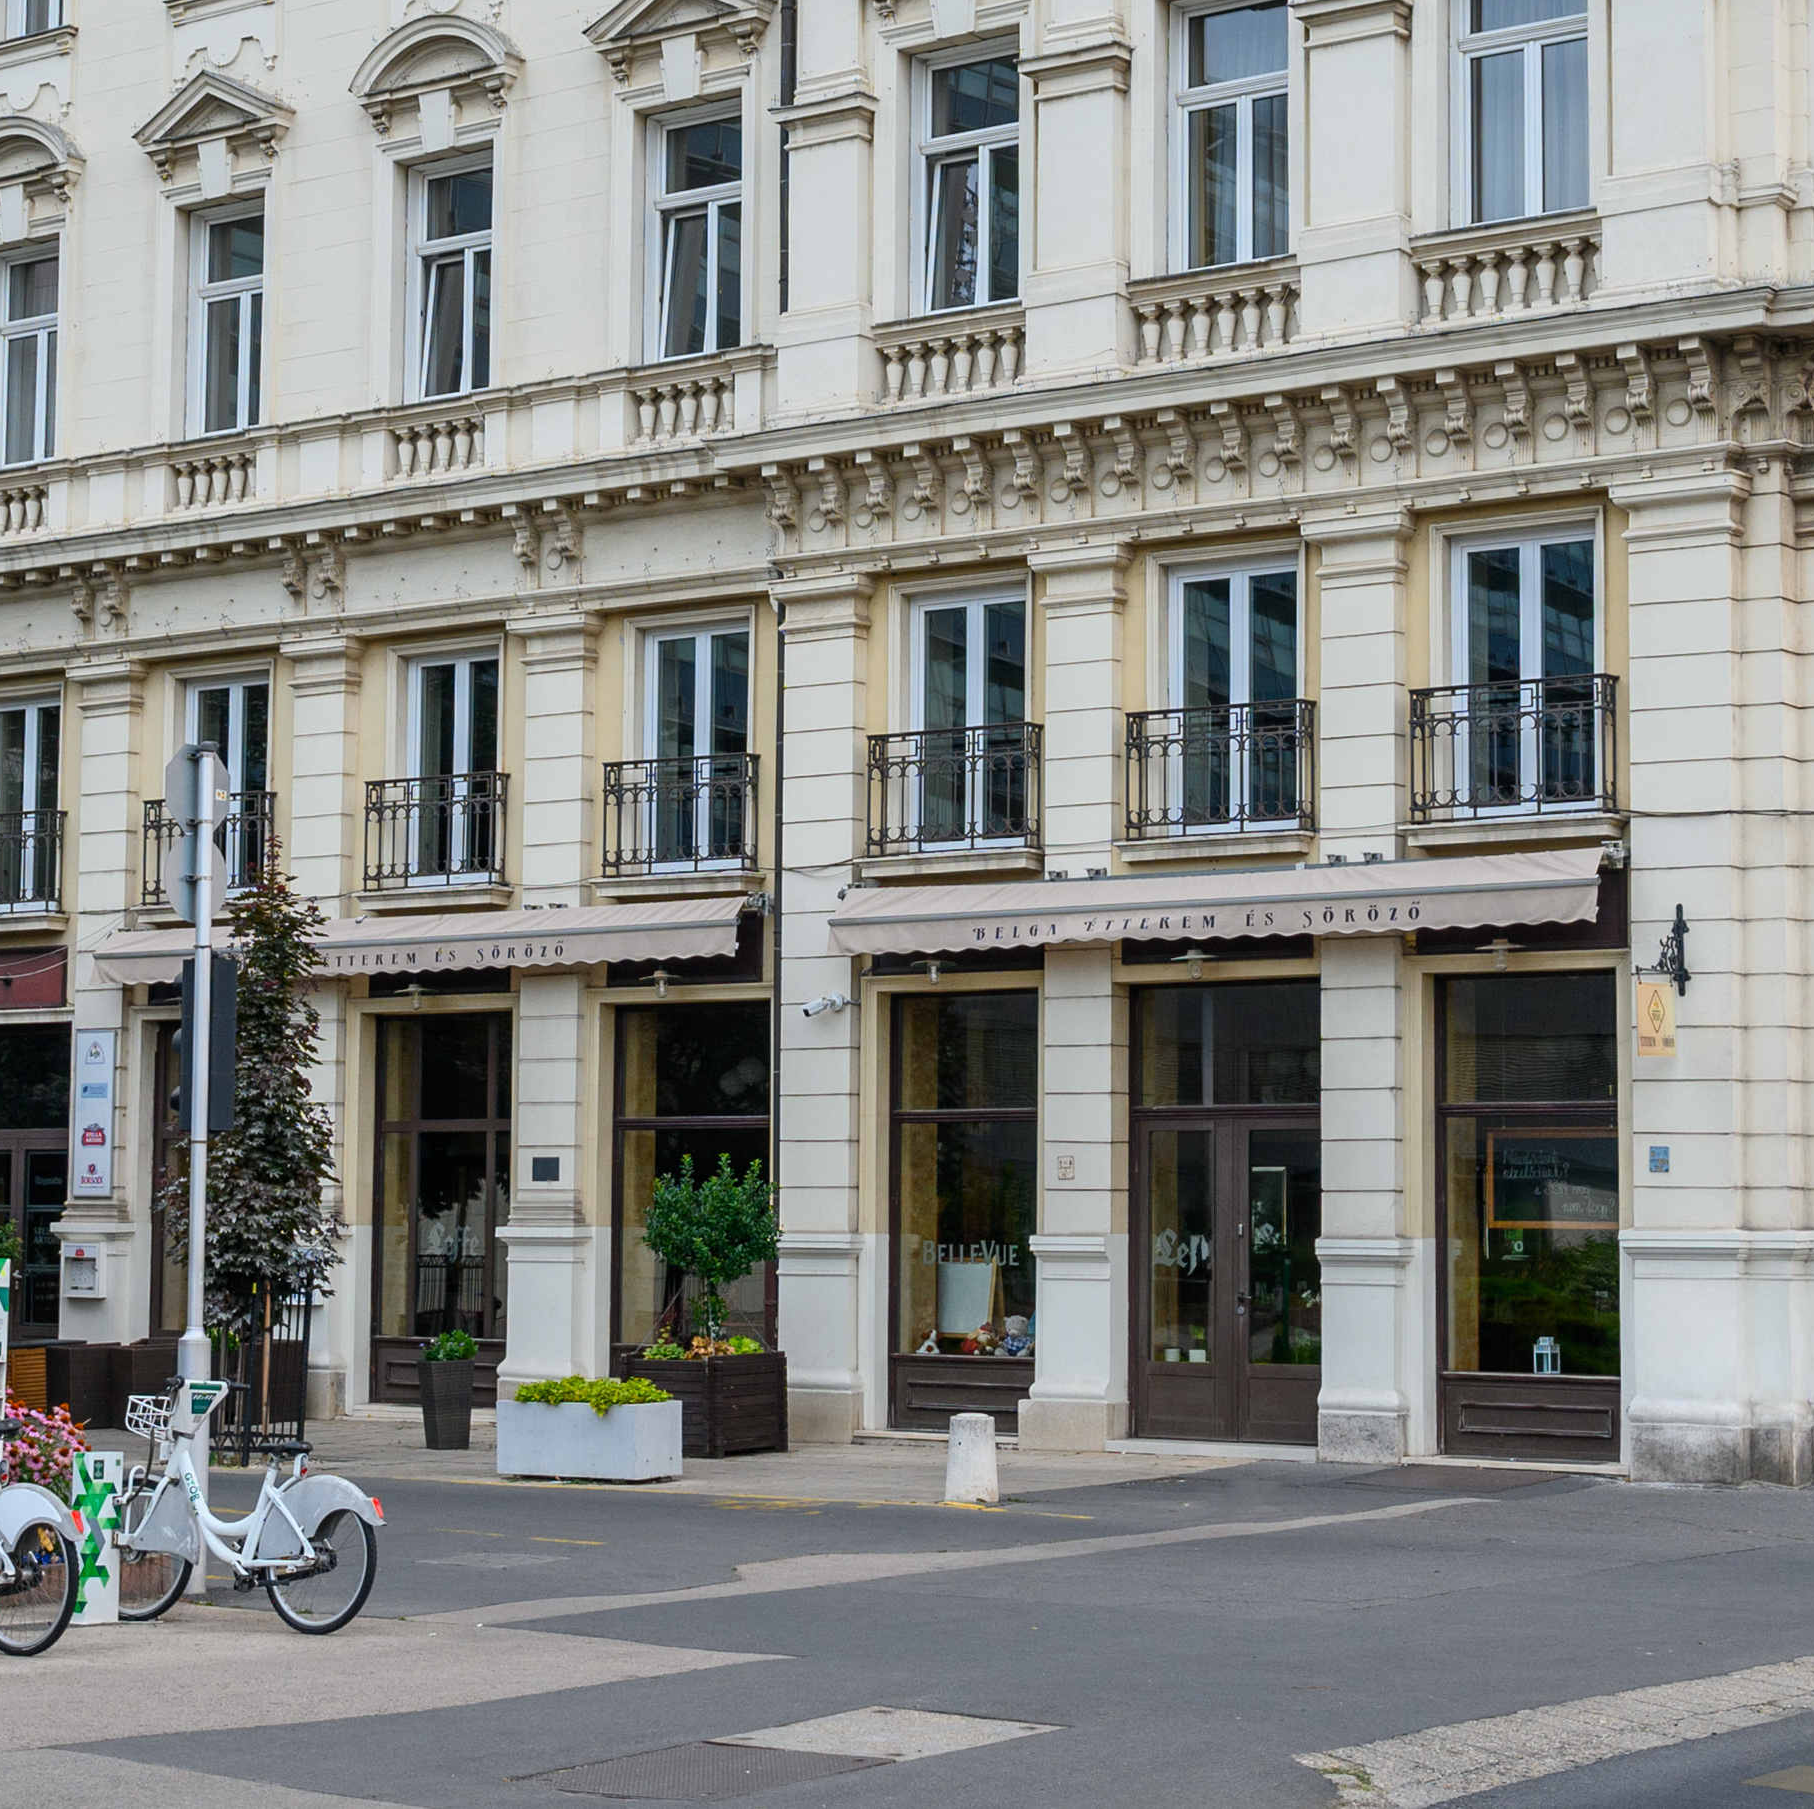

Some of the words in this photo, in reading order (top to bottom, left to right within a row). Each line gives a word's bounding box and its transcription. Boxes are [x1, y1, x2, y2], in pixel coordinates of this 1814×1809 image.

[973, 923, 1056, 941] BELGA
[1084, 915, 1215, 932] ÉTTEREM
[1245, 909, 1274, 927] ÉS
[1302, 901, 1421, 929] SÖRÖZŐ
[320, 951, 417, 968] ÉTTEREM
[434, 947, 456, 963] ÉS
[476, 940, 564, 963] SÖRÖZŐ
[80, 1175, 103, 1185] BORSODI
